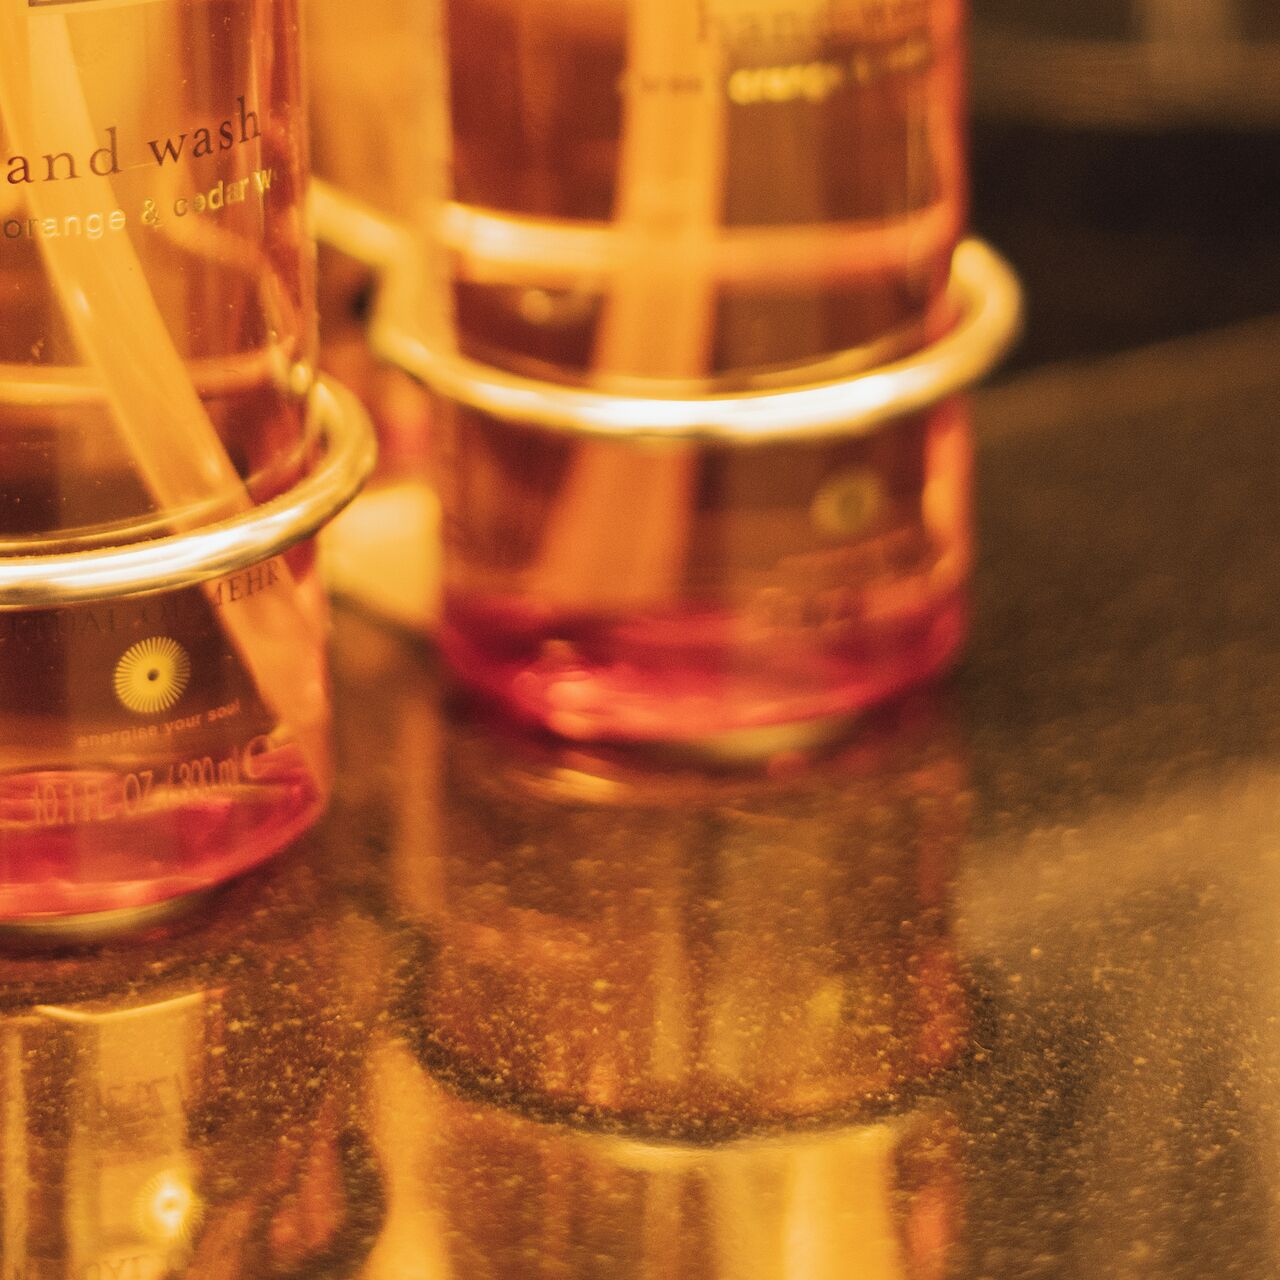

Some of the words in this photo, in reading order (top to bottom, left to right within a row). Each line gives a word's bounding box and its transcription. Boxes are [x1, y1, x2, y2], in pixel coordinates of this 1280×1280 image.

[147, 94, 262, 168] wash
[3, 208, 127, 242] orange
[142, 198, 164, 228] &
